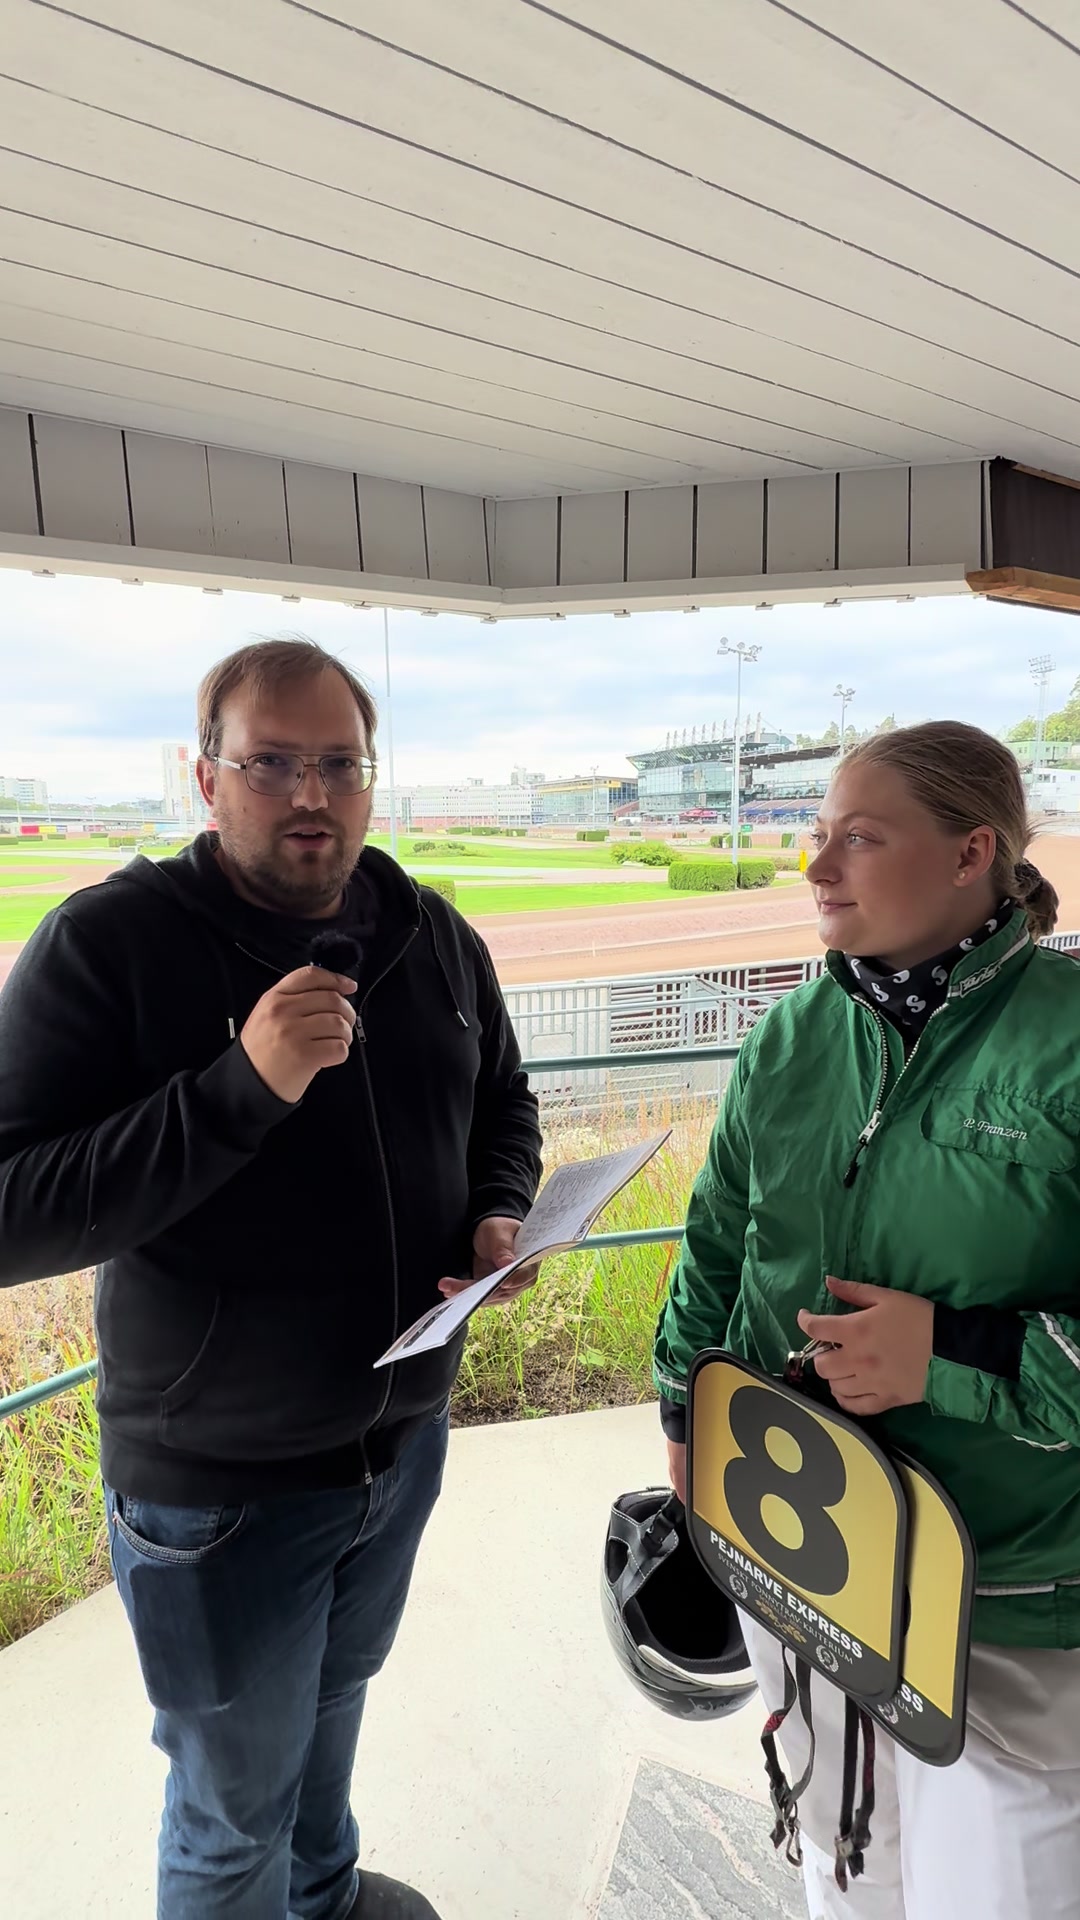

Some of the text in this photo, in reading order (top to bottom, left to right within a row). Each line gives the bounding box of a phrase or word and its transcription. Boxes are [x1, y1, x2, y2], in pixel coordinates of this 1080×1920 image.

[723, 1384, 850, 1597] 8
[710, 1530, 783, 1600] PEJNARVE
[787, 1591, 863, 1659] EXPRESS
[717, 1552, 750, 1583] SVENSKT
